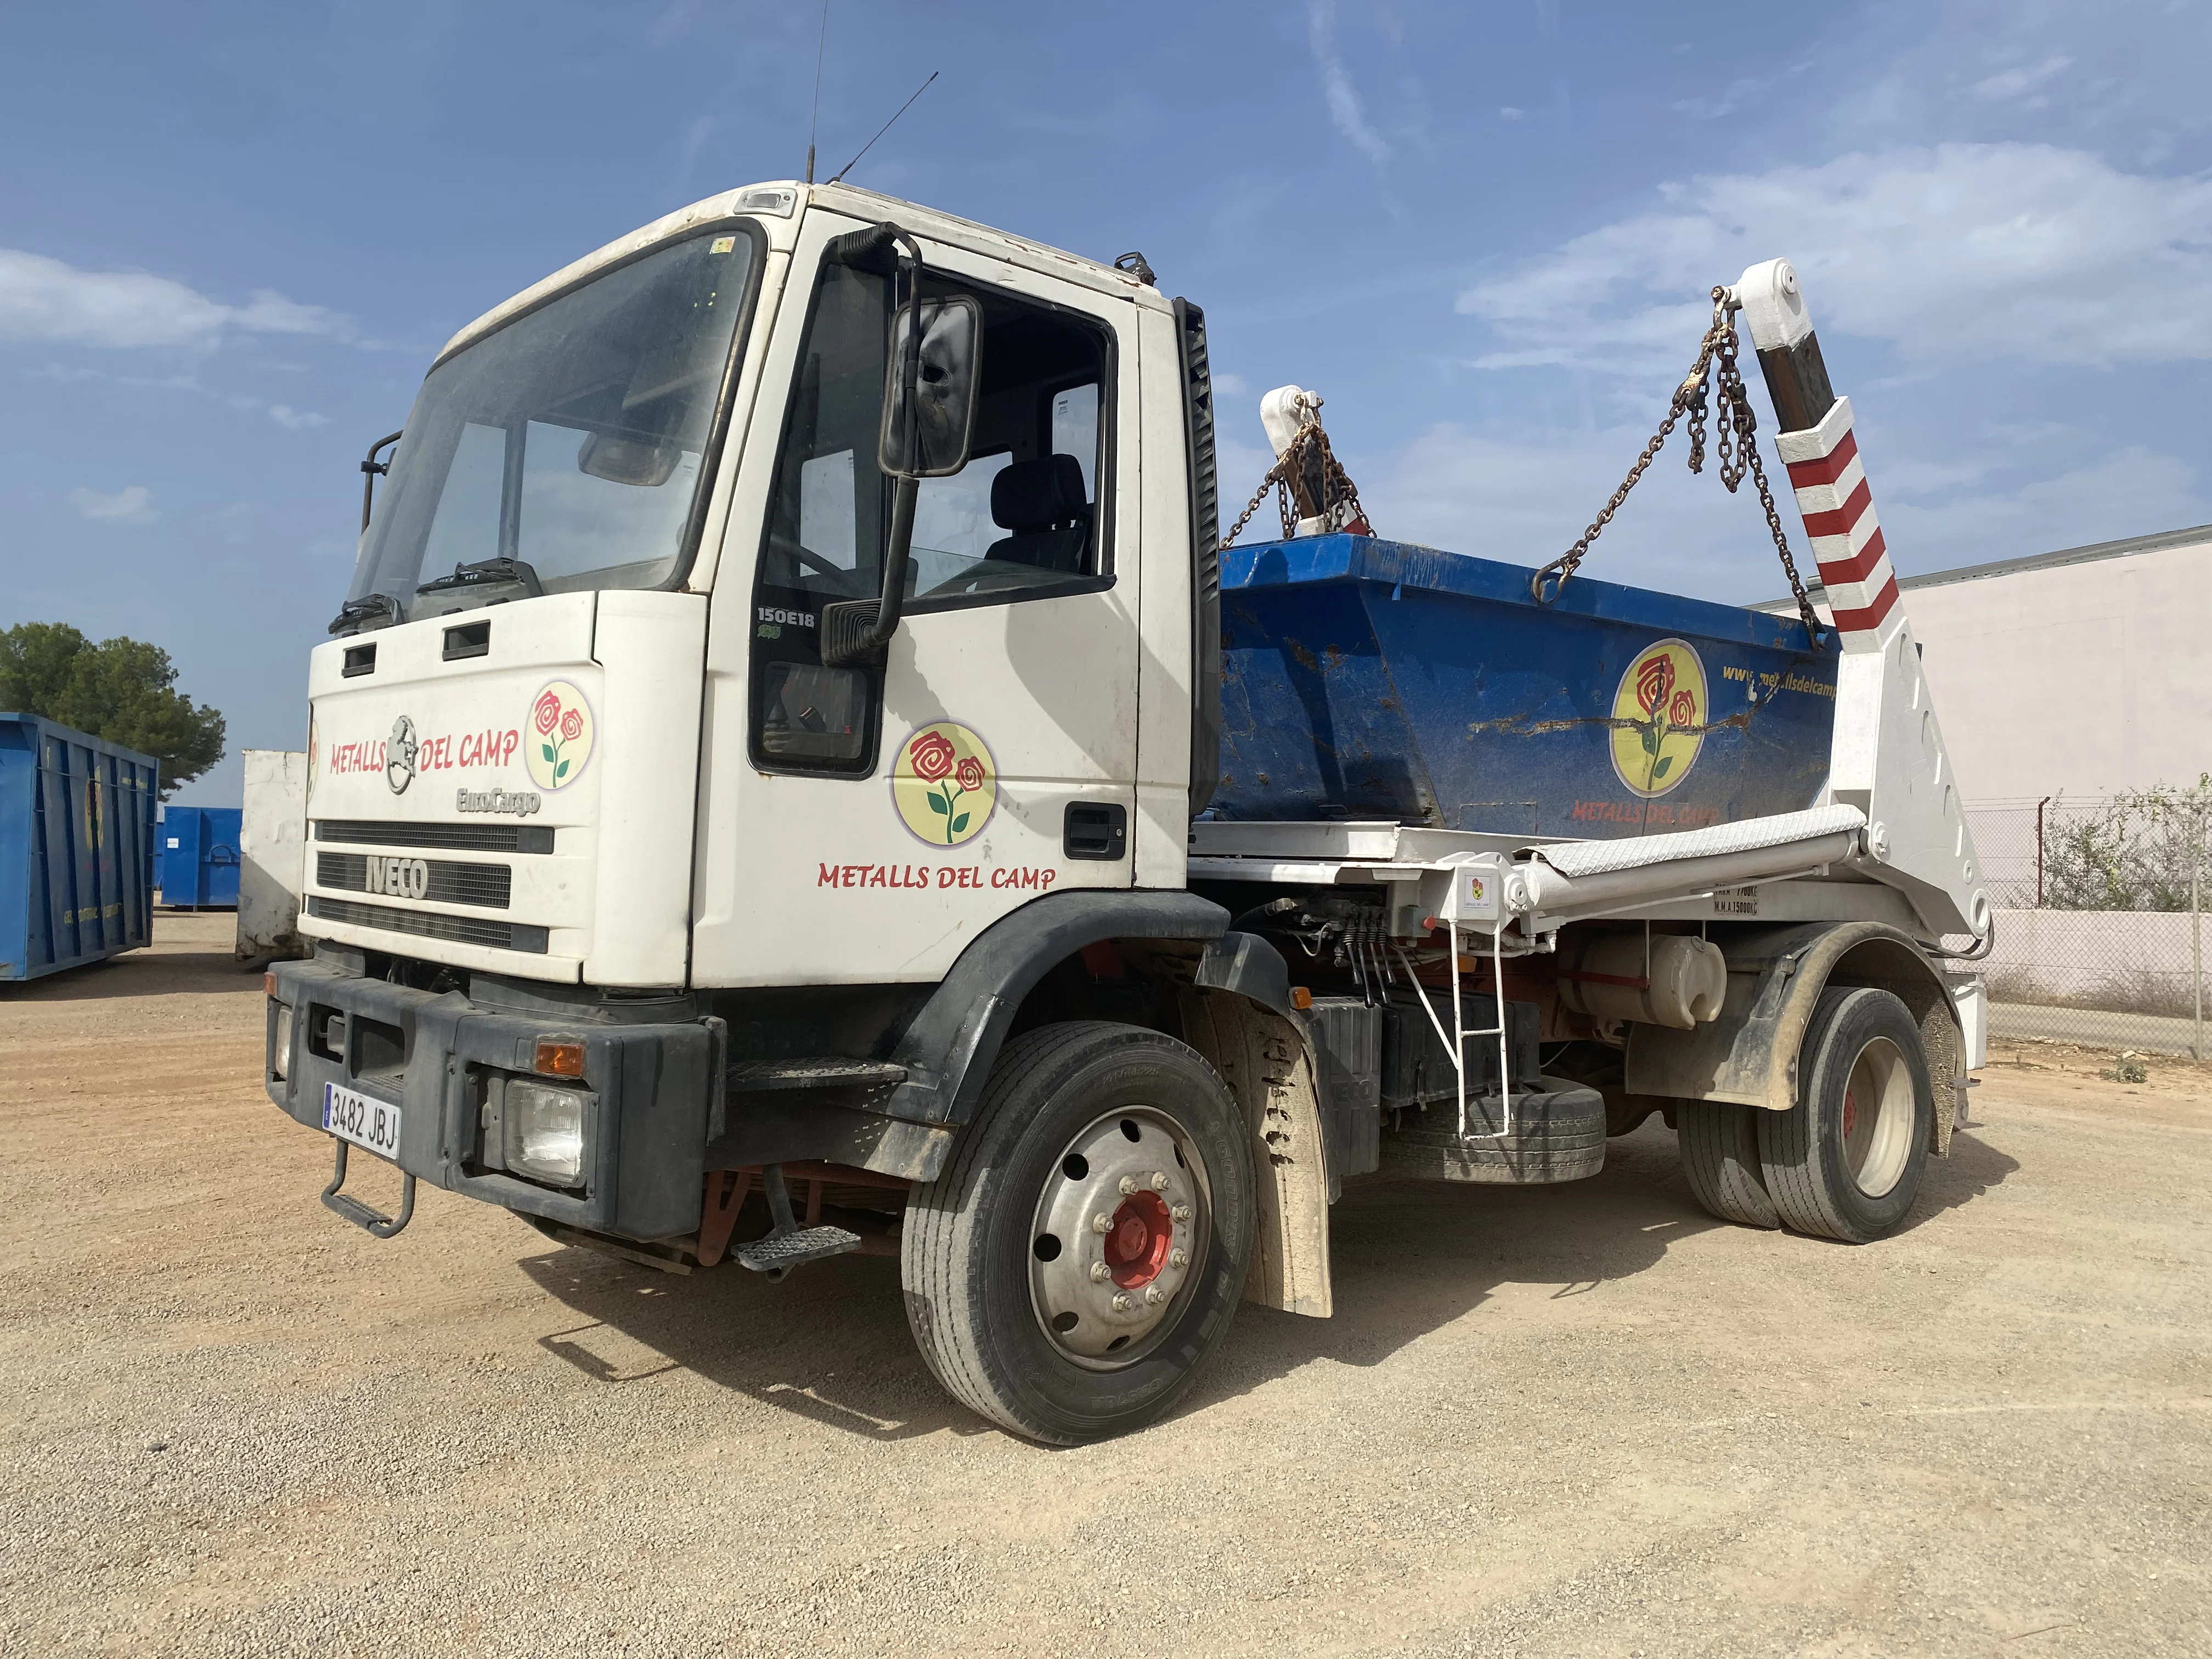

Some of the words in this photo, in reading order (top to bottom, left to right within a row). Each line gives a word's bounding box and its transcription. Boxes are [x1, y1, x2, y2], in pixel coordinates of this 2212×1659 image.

[758, 607, 815, 628] 150E18
[330, 740, 386, 775] METALLS
[420, 735, 453, 772] DEL
[459, 729, 519, 768] CAMP
[456, 787, 541, 817] EuroCargo
[1572, 799, 1644, 823] METALLS
[1645, 805, 1673, 822] DEL
[365, 856, 428, 900] IVECO
[817, 863, 930, 889] METALLS
[936, 867, 984, 889] DEL
[991, 867, 1056, 890] CAMP
[332, 1092, 364, 1138] 3482
[368, 1107, 396, 1150] JBJ
